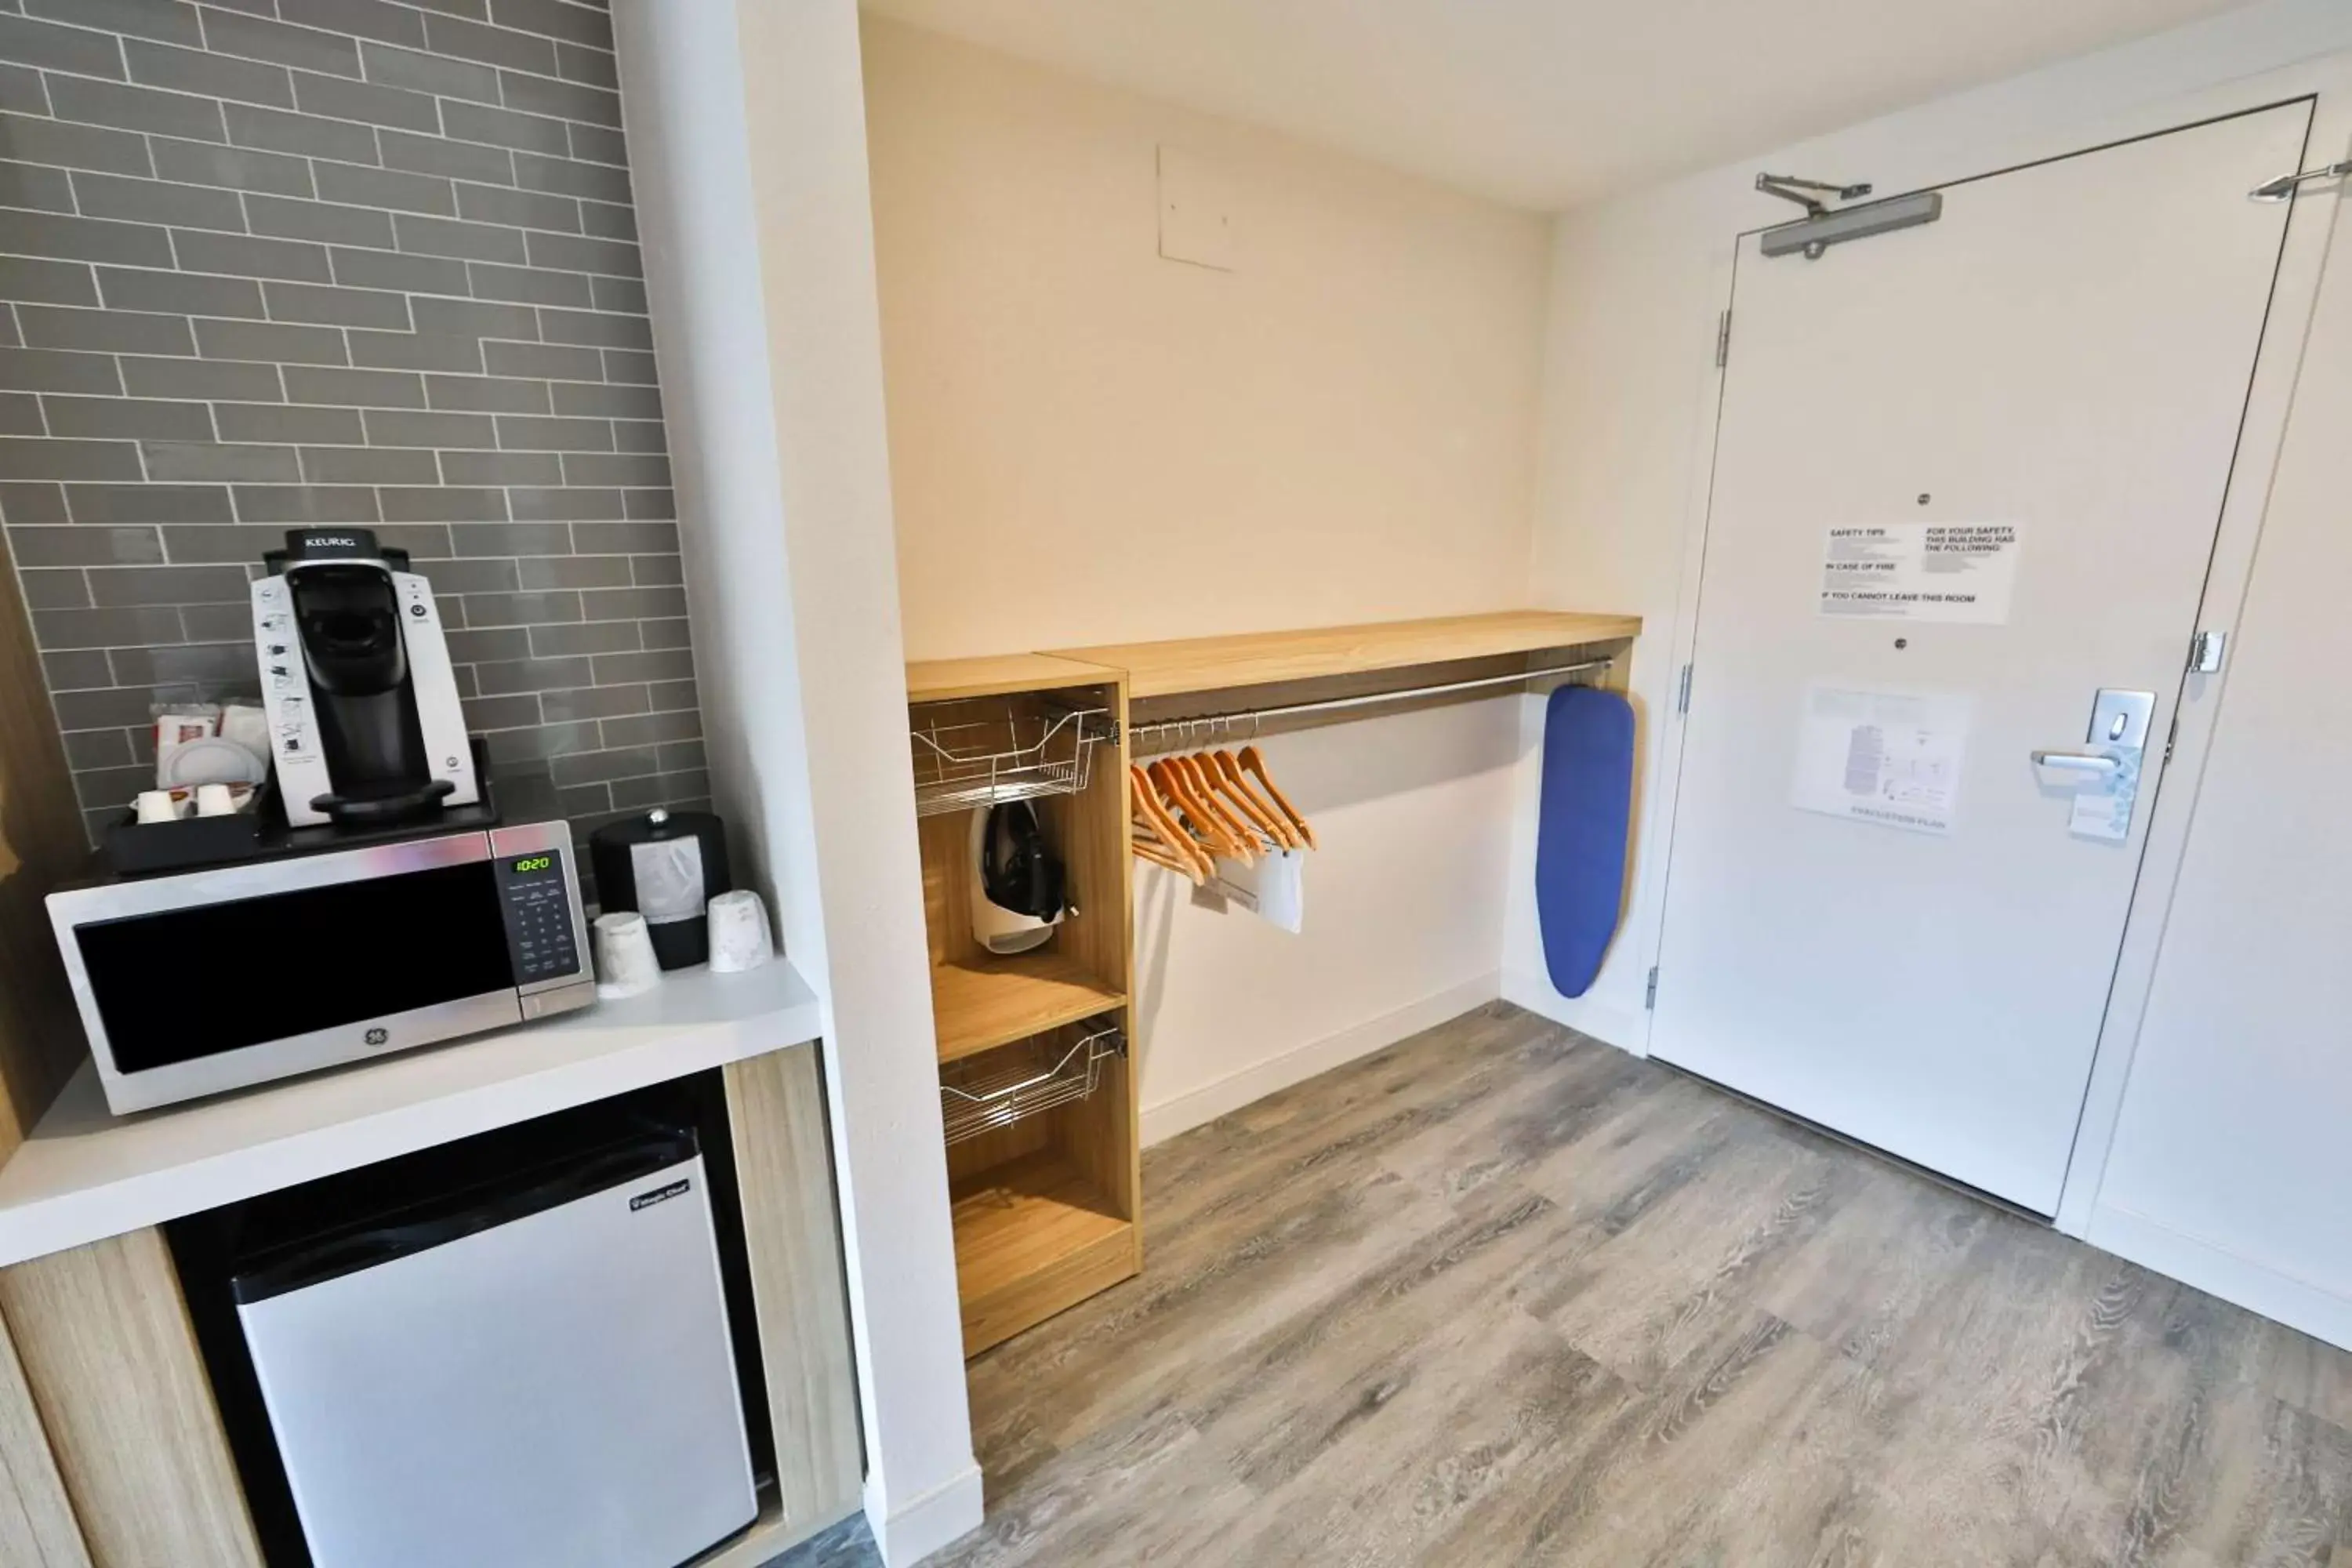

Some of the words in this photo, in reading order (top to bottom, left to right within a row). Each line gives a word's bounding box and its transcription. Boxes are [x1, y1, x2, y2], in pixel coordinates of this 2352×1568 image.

[1831, 528, 1864, 537] SAFETY
[305, 537, 356, 546] KEURIG
[1994, 534, 2015, 543] HAS
[1851, 592, 1887, 601] CANNOT
[1889, 593, 1919, 601] LEAVE
[1922, 593, 1943, 602] THIS
[1944, 593, 1976, 603] ROOM
